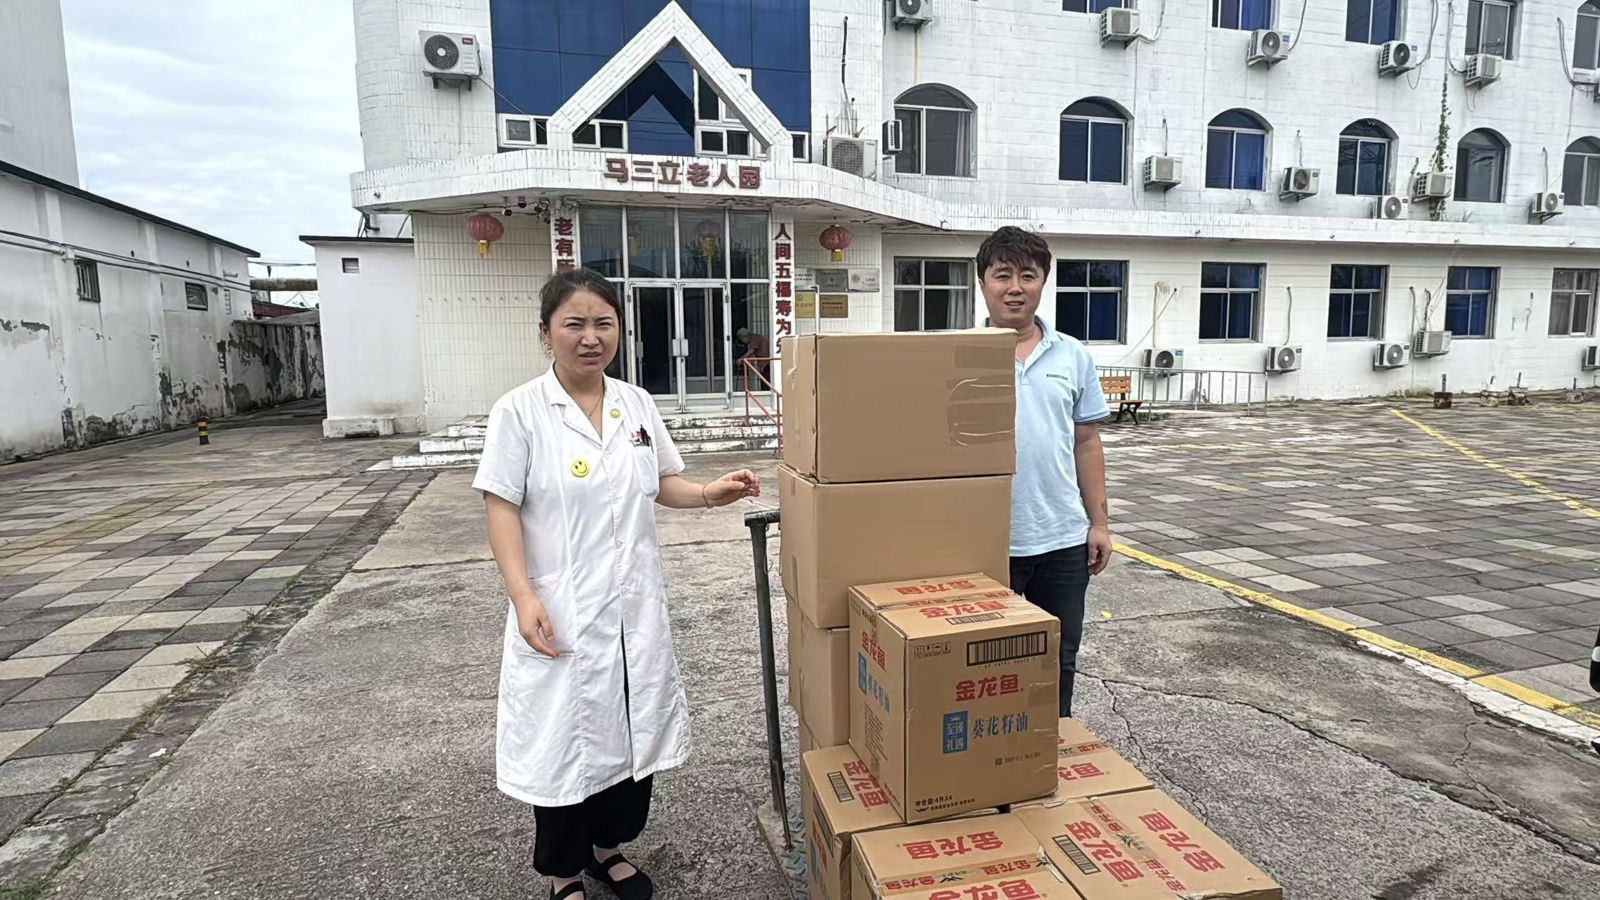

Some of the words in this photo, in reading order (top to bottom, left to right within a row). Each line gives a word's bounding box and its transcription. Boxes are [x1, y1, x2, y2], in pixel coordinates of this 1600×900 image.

[604, 158, 761, 190] 马三立老人园
[894, 580, 976, 595] 金龙鱼
[919, 601, 1008, 618] 金龙鱼
[956, 674, 1019, 702] 金龙鱼
[973, 711, 1028, 739] 葵花籽油
[843, 760, 889, 808] 金龙鱼
[1058, 763, 1104, 780] 龙鱼
[902, 831, 1003, 860] 金龙鱼
[1065, 820, 1144, 882] 金龙鱼
[1138, 811, 1225, 873] 金龙鱼
[982, 860, 1031, 875] 金龙鱼
